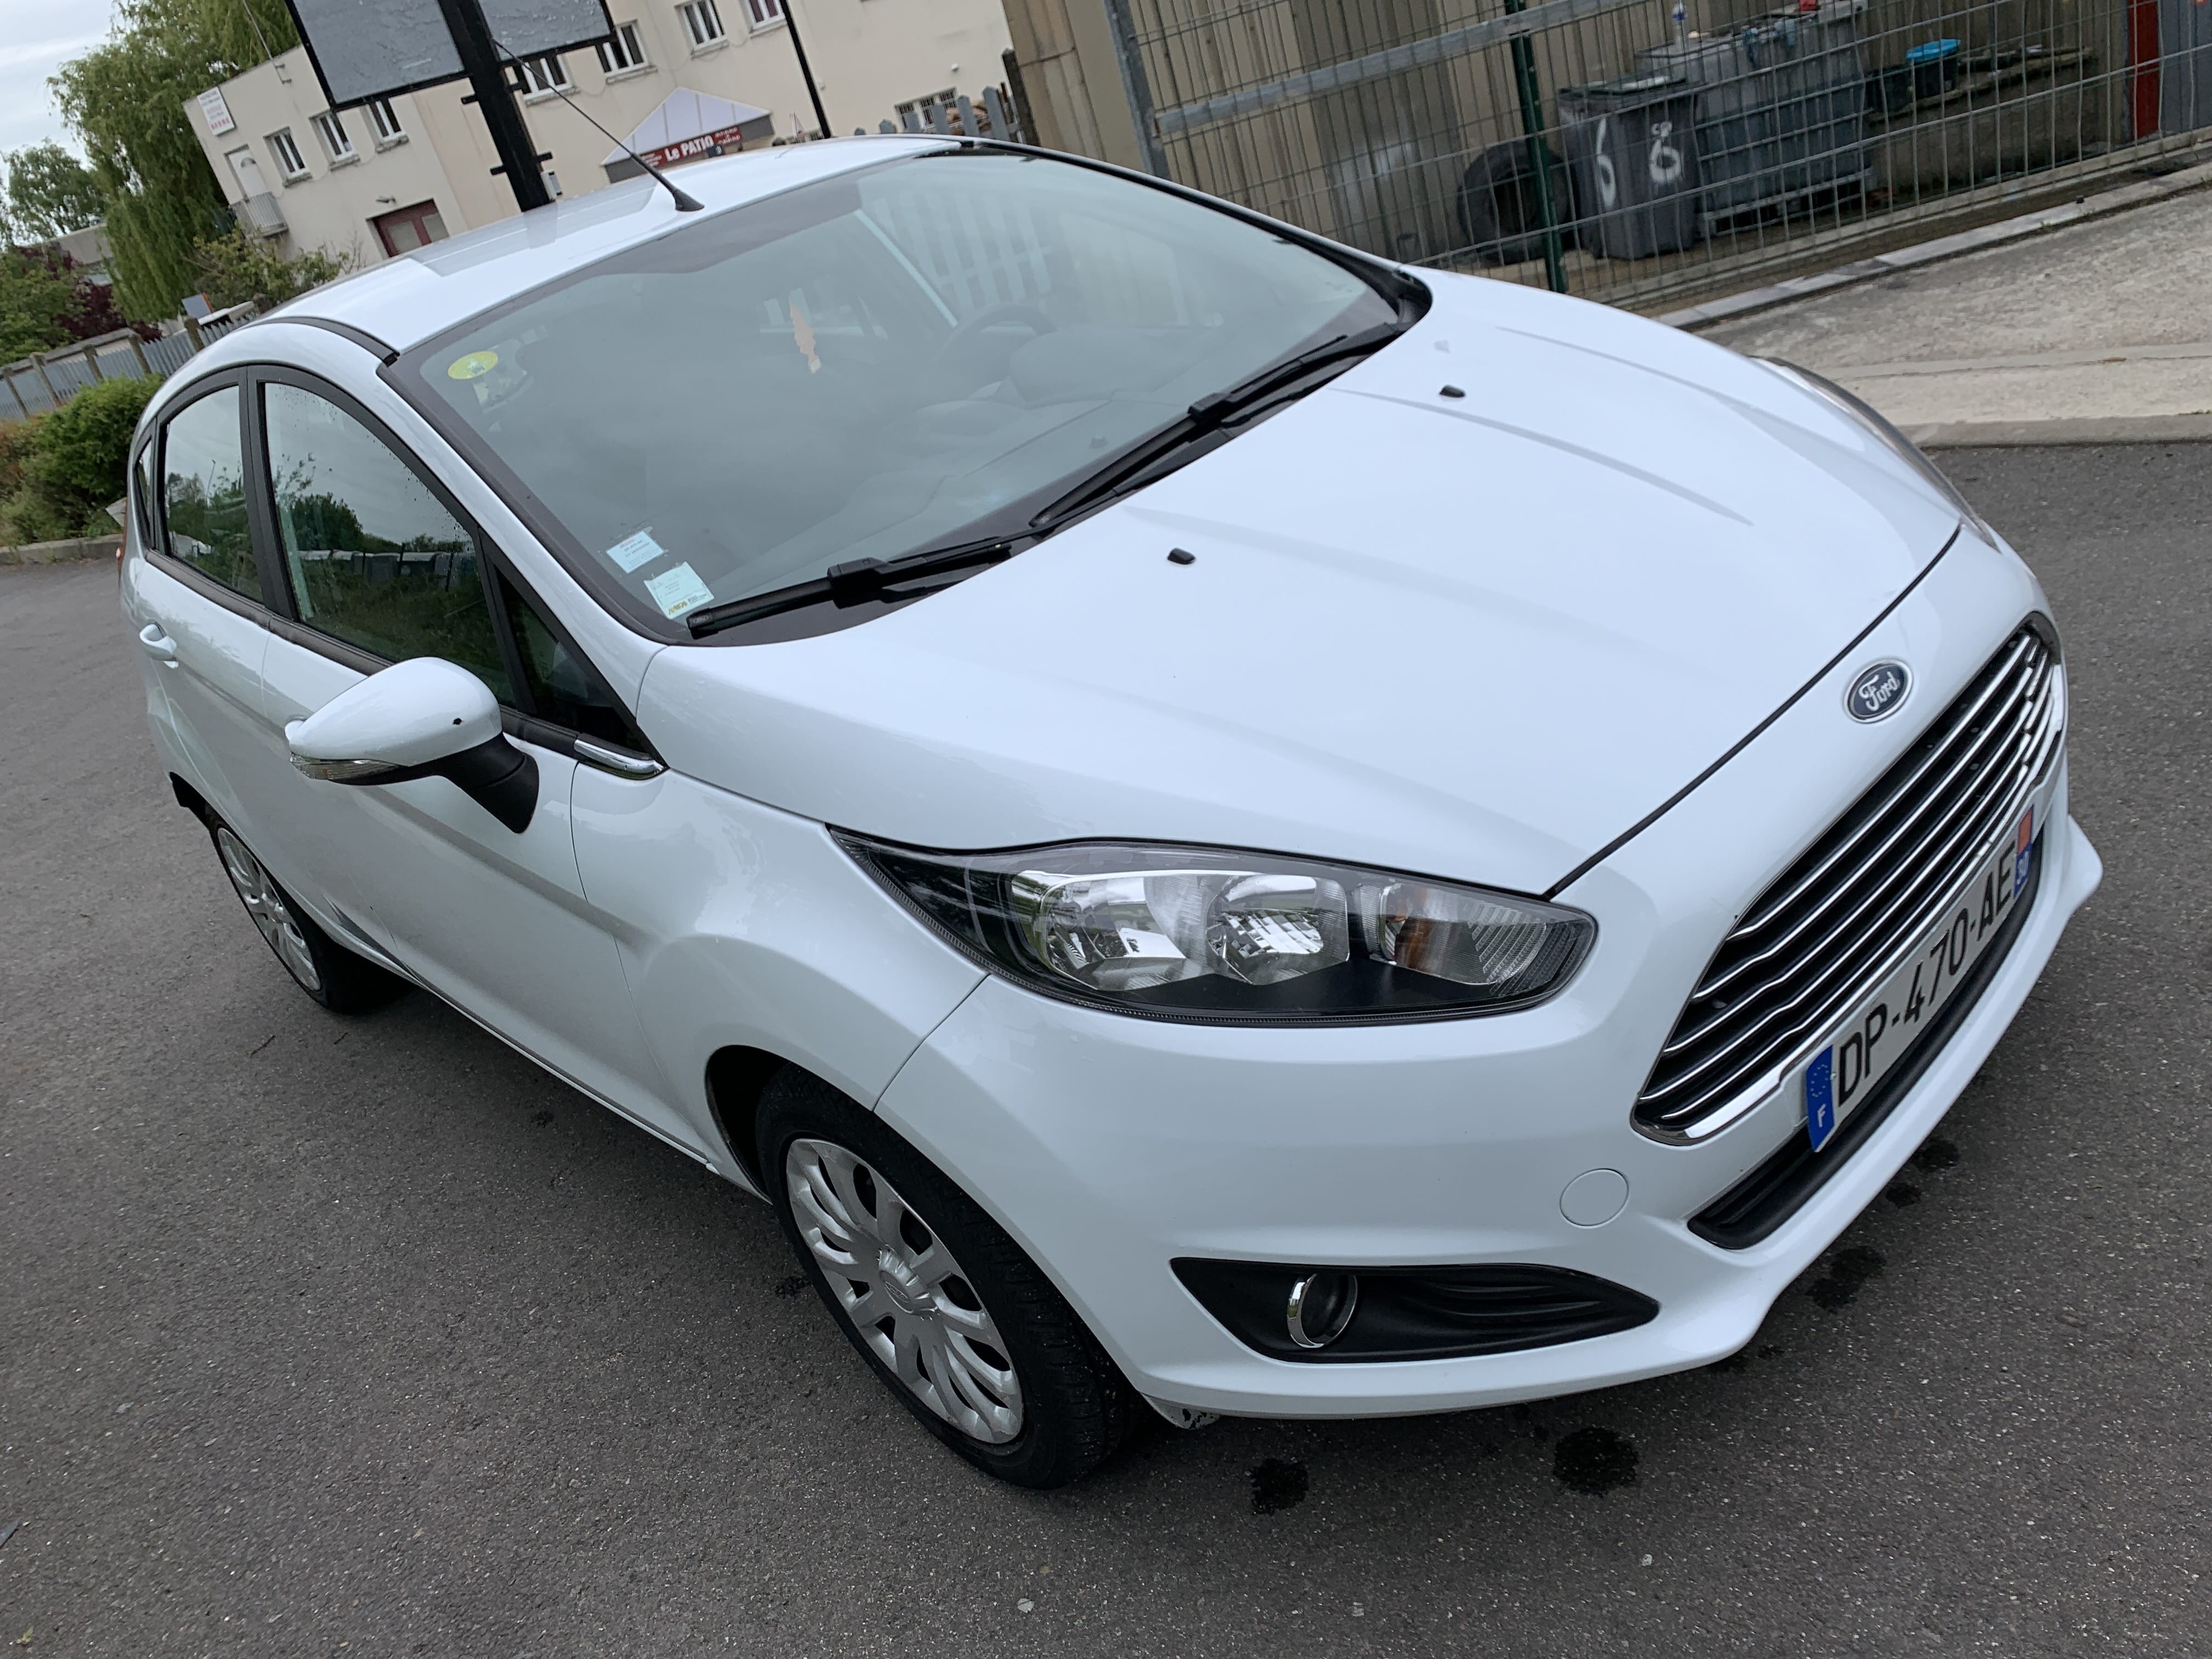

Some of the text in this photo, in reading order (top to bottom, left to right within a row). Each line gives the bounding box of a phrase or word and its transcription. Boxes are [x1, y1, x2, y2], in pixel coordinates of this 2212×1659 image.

[680, 135, 714, 156] PATIO
[1858, 671, 1901, 712] Ford
[1838, 839, 2016, 1107] DP-470-AE
[1817, 1103, 1827, 1128] F
